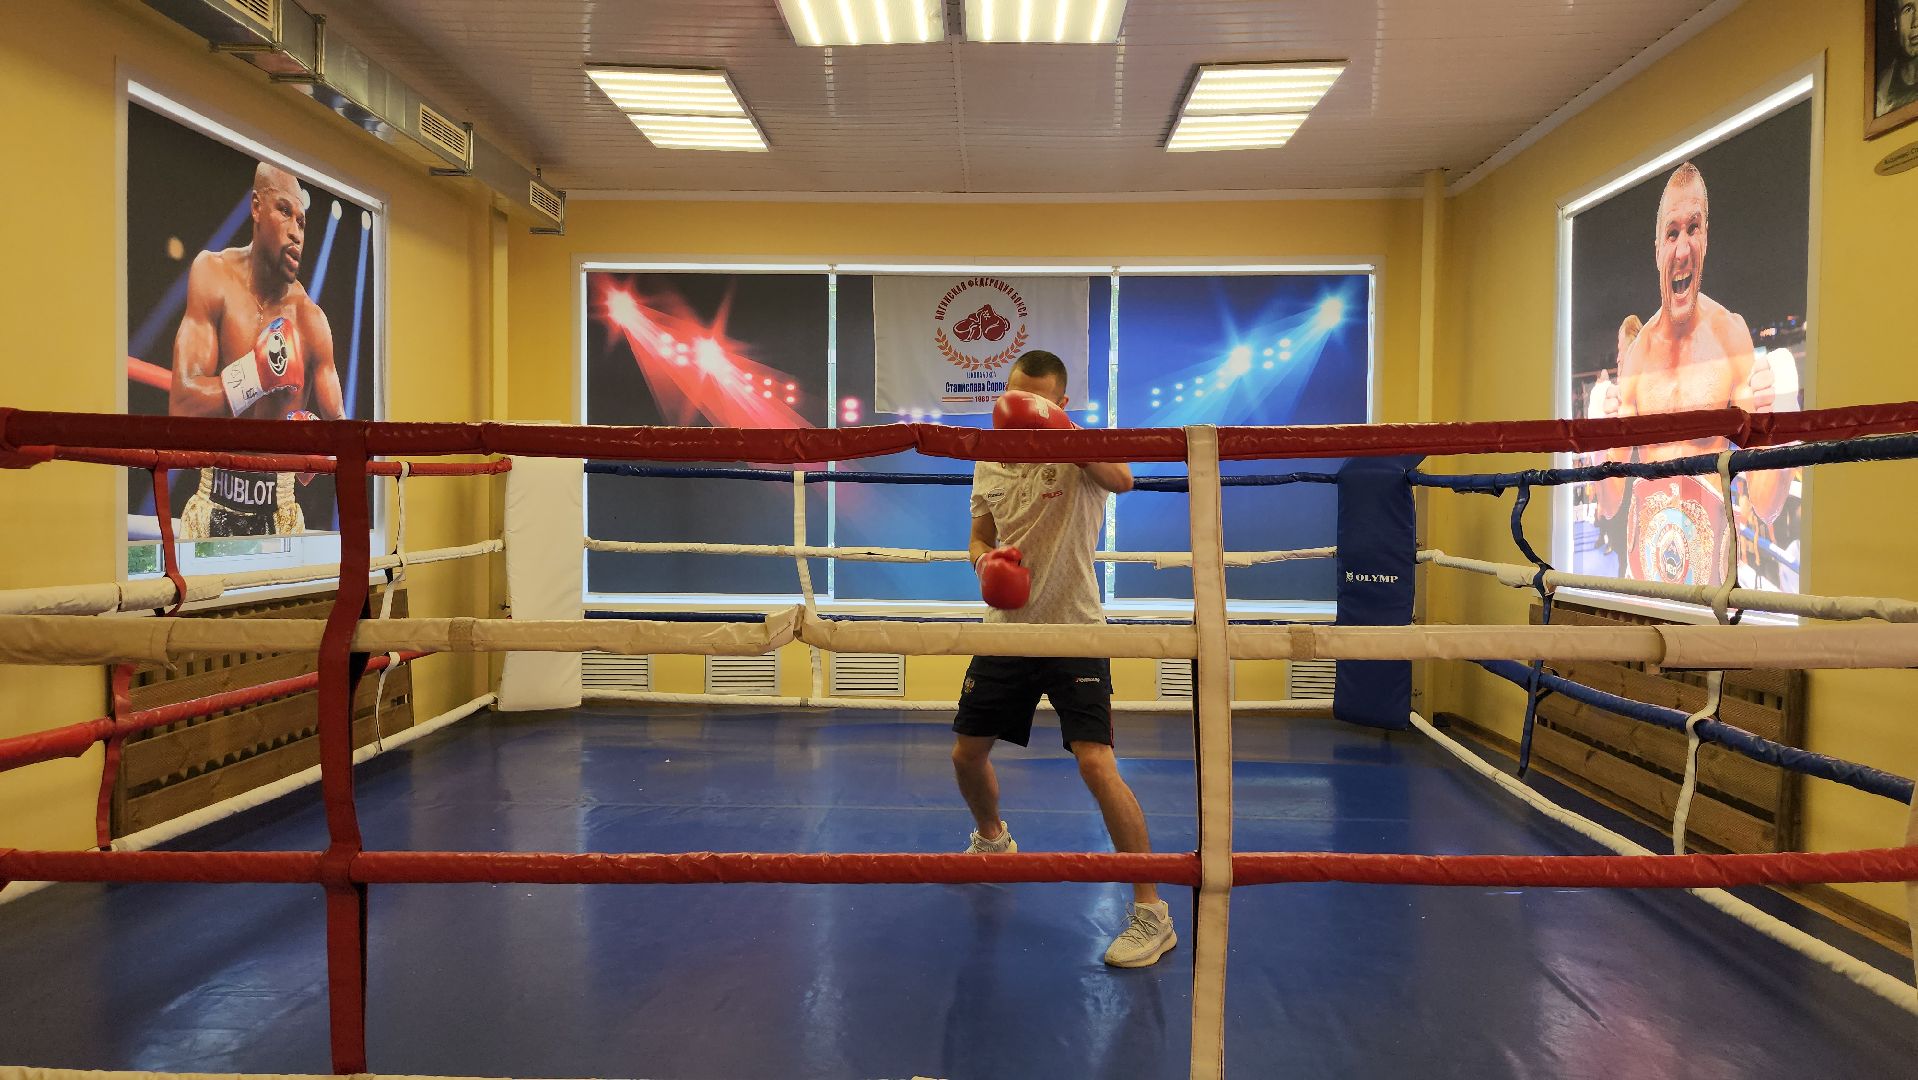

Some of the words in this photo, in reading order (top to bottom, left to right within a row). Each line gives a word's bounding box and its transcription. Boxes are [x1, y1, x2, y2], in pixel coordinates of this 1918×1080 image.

[967, 277, 1014, 296] ФЕДЕРАЦИЯ
[1010, 292, 1028, 318] БОКСА
[213, 469, 275, 506] HUBLOT
[1355, 574, 1399, 584] OLYMP
